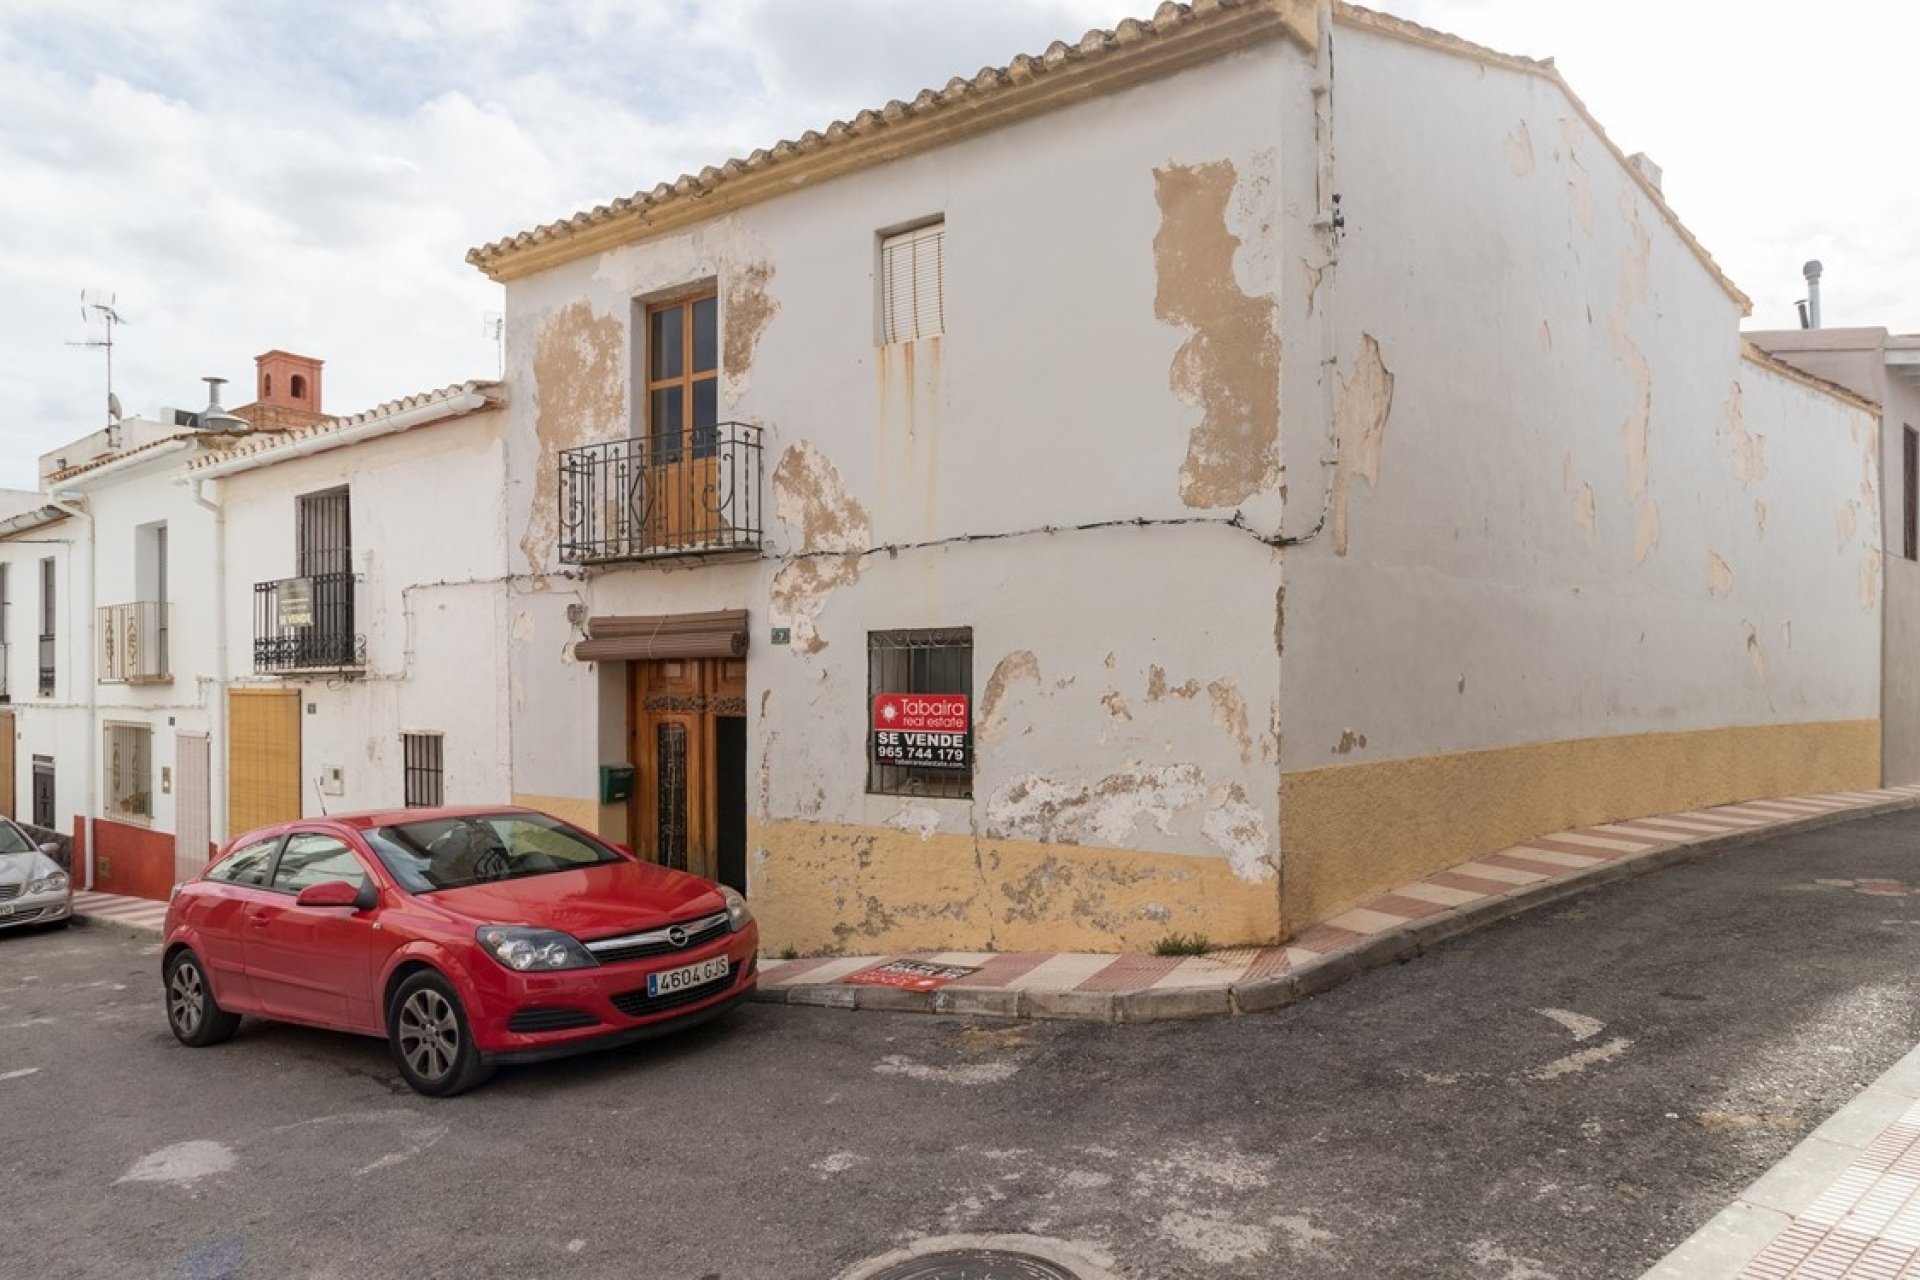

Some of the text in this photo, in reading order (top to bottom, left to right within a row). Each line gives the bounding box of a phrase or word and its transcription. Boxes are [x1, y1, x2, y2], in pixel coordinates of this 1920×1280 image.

[900, 698, 964, 715] Tabaira
[903, 716, 964, 728] real estate
[878, 732, 964, 747] SE VENDE
[878, 746, 964, 761] 965 744 179
[660, 969, 700, 990] 4604
